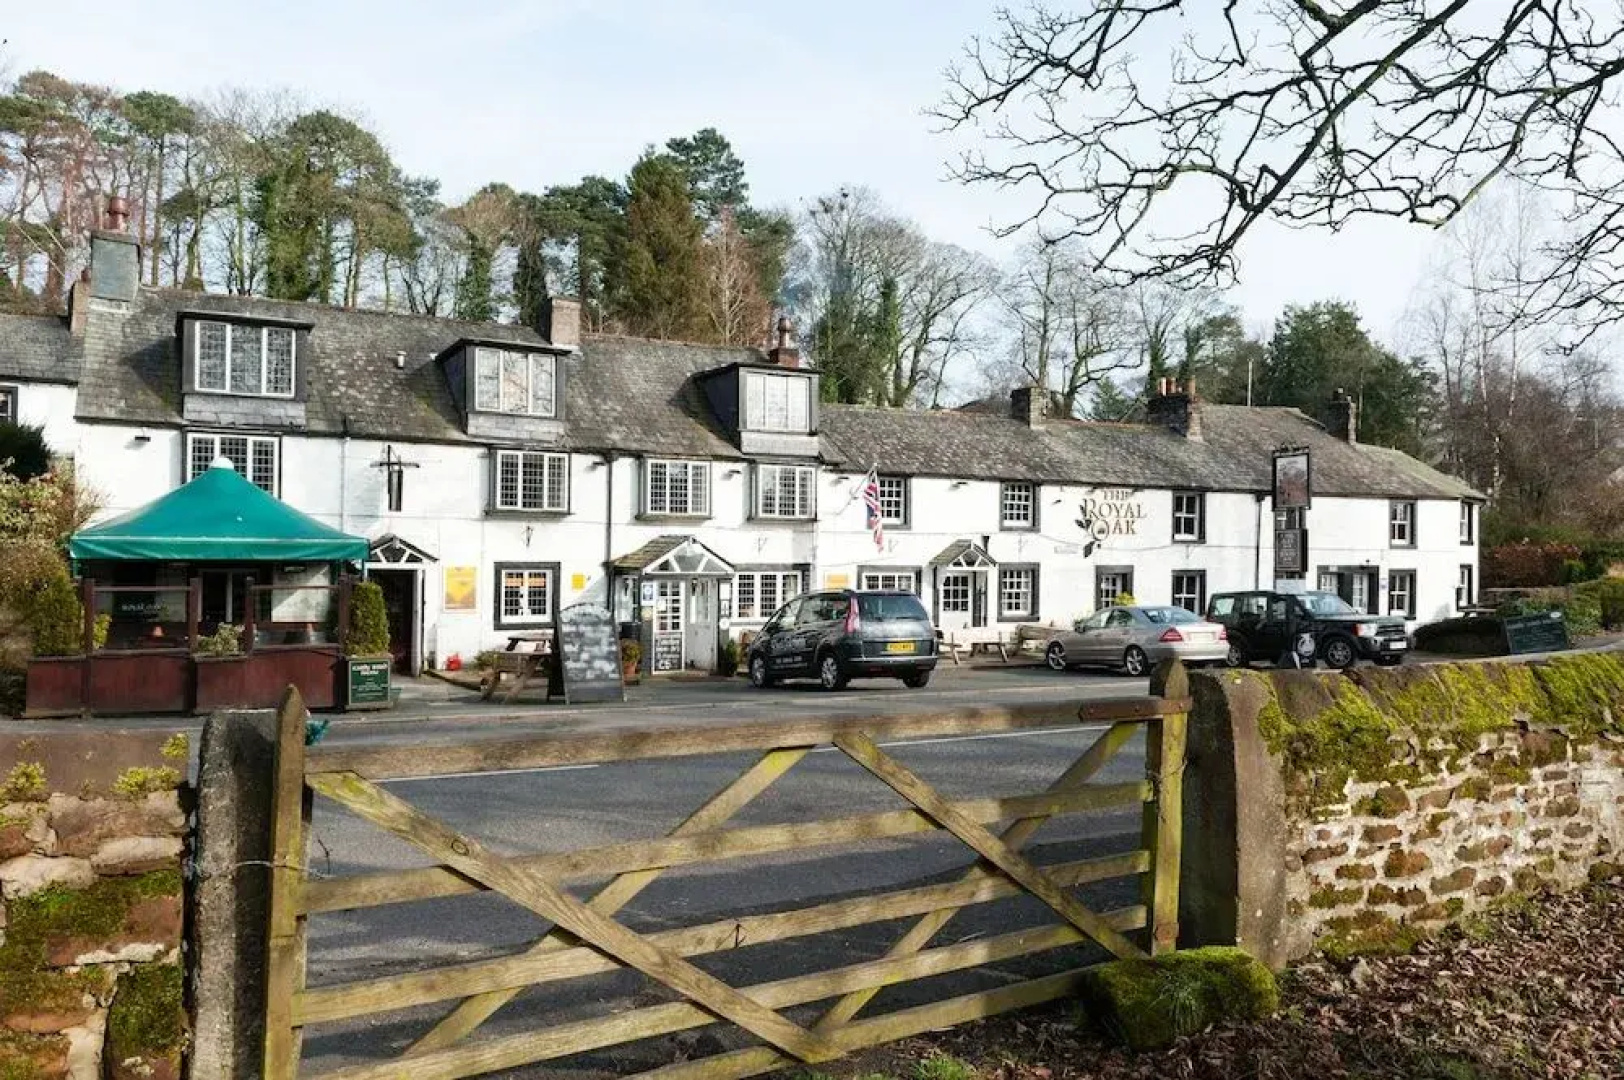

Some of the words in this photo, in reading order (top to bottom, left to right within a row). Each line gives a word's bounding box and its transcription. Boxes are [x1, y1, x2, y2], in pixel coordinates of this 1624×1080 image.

[1102, 489, 1131, 500] THE
[1082, 498, 1147, 519] ROYAL
[1091, 519, 1138, 541] OAK
